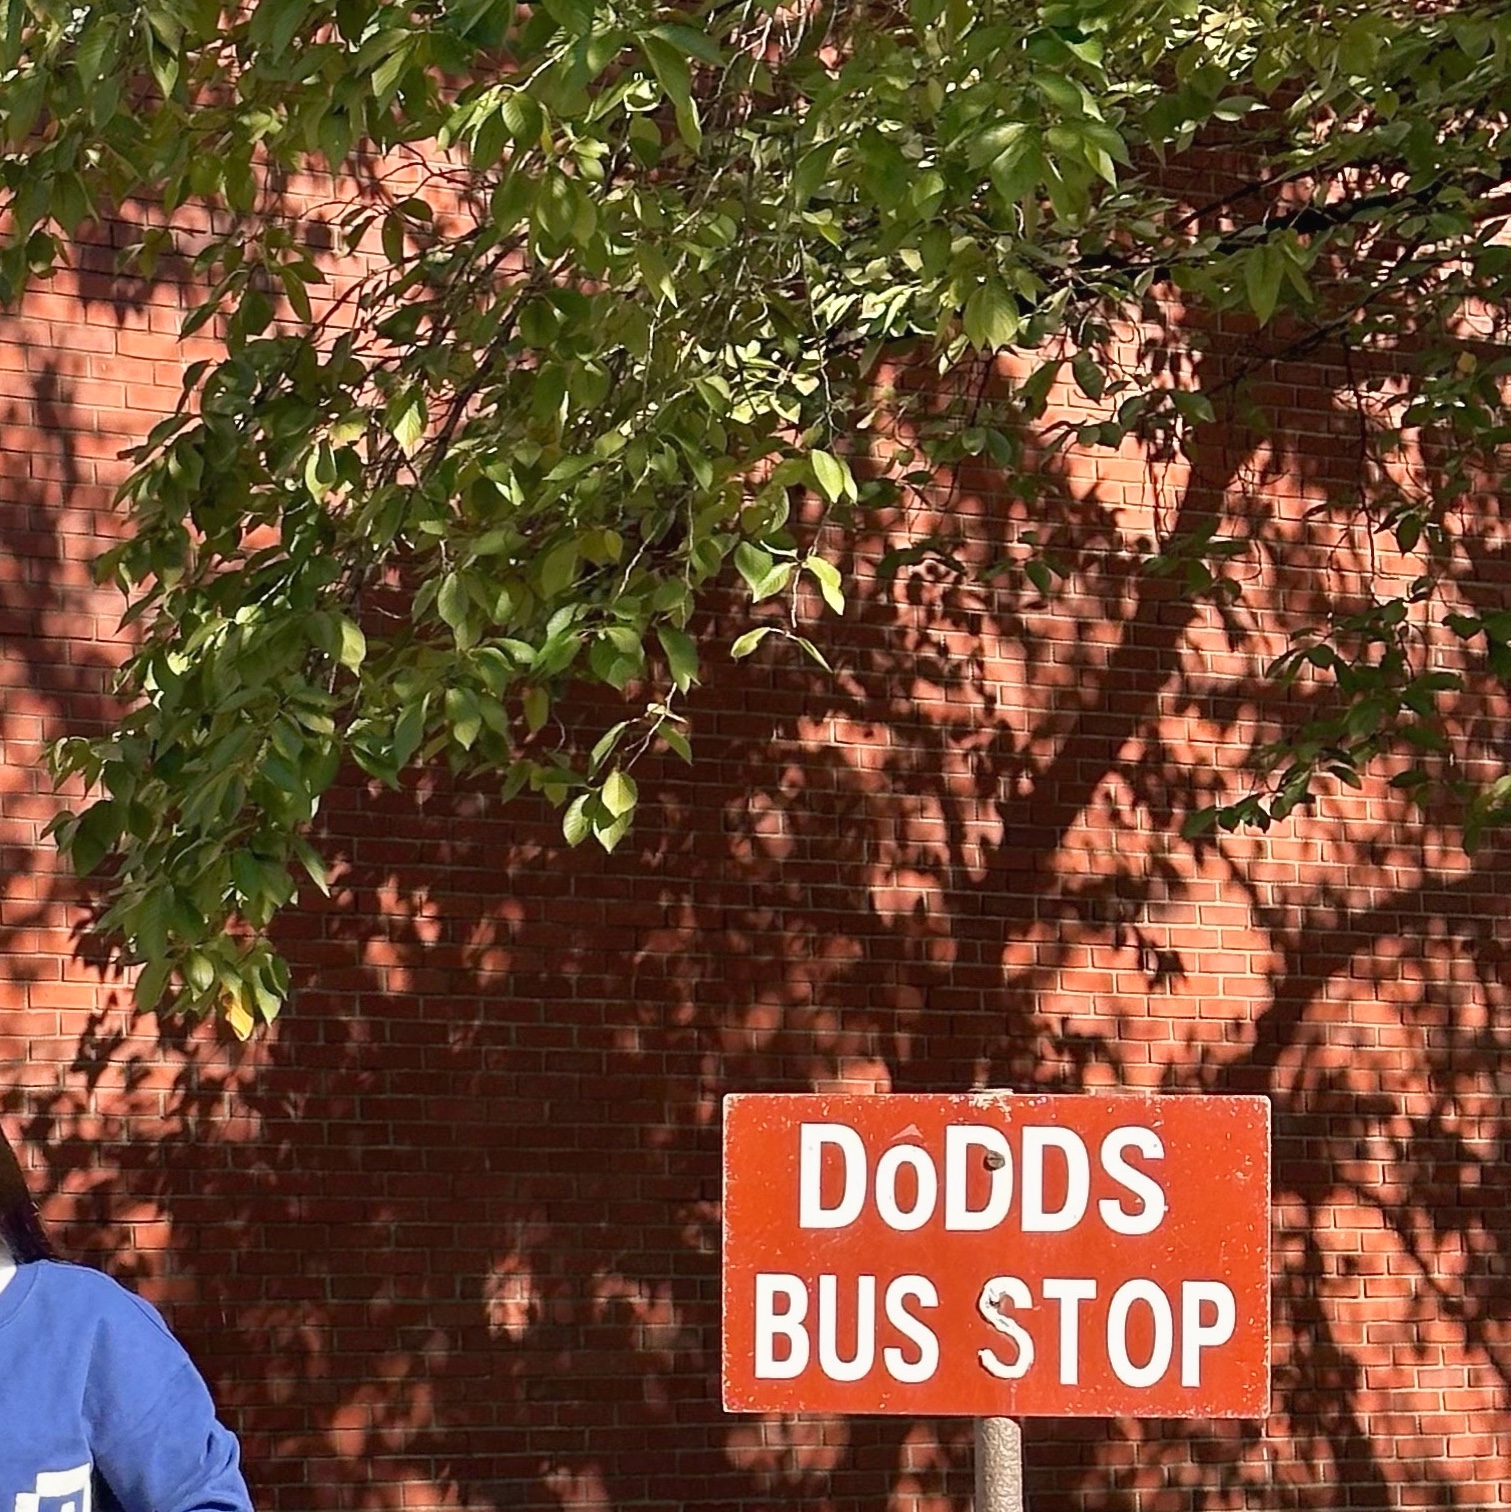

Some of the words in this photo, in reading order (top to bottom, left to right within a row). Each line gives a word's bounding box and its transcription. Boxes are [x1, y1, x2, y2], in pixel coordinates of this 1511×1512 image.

[799, 1123, 1168, 1235] DoDDS
[754, 1273, 940, 1383] BUS
[976, 1276, 1236, 1388] STOP
